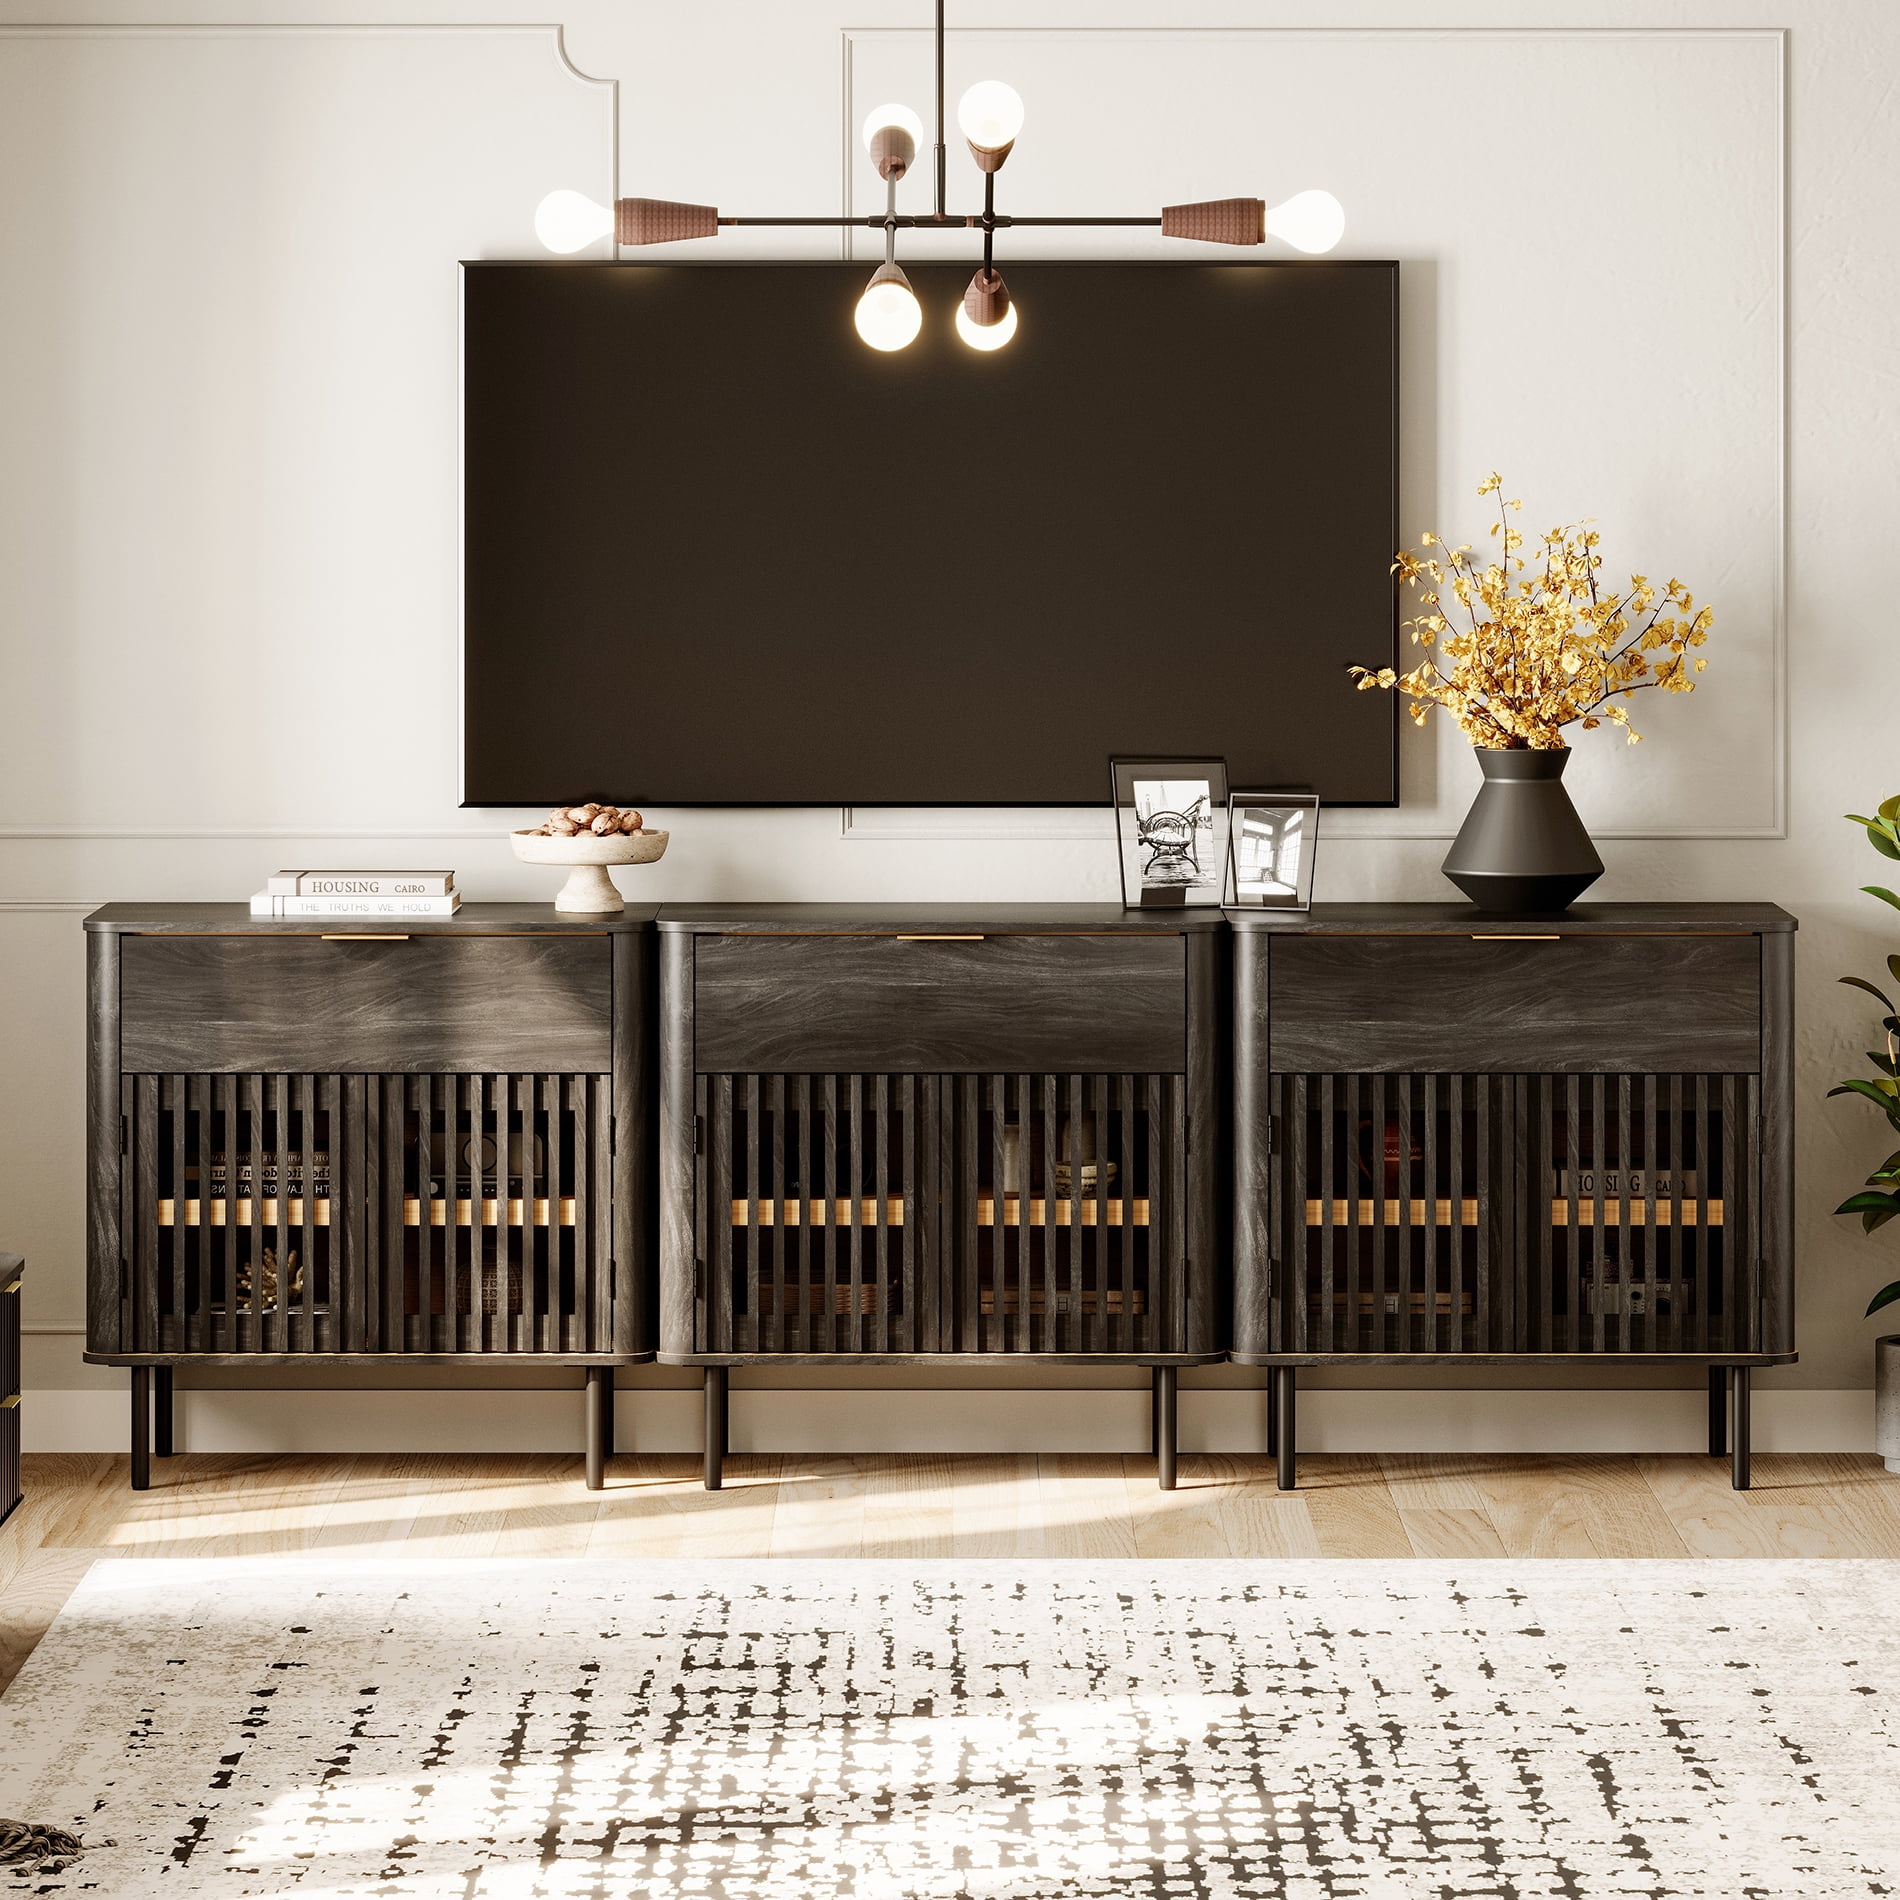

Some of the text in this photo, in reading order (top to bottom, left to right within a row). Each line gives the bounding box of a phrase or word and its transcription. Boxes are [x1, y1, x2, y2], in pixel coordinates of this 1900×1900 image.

[312, 881, 426, 894] HOUSING CAIRO
[299, 903, 431, 912] THE TRUTHS WE HOLD
